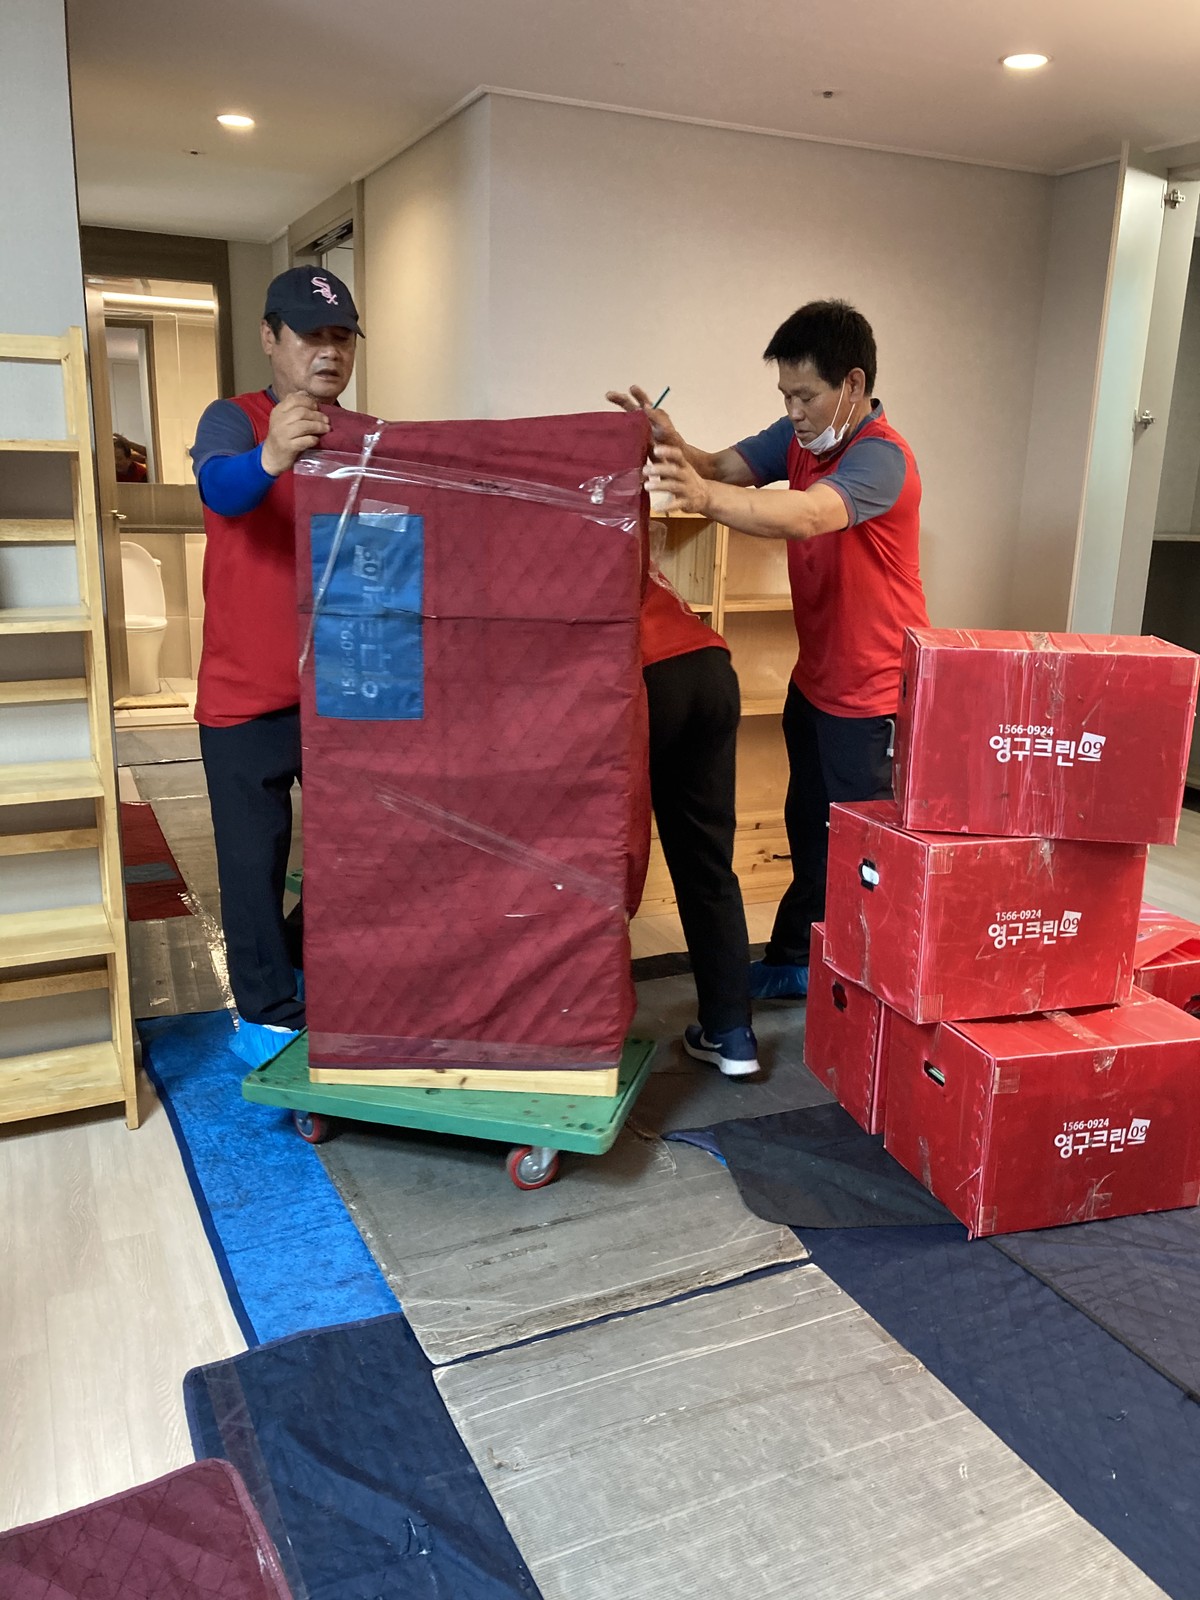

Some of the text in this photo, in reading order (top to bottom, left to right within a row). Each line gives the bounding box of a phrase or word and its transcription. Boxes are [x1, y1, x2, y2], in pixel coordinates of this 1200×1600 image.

[341, 618, 356, 696] 1566-092
[998, 724, 1054, 736] 1566-0924
[989, 735, 1076, 767] 영구크린
[995, 909, 1042, 922] 1566-0924
[988, 920, 1059, 949] 영구크린
[1063, 1118, 1110, 1131] 1566-0924
[1054, 1128, 1127, 1159] 영구크린
